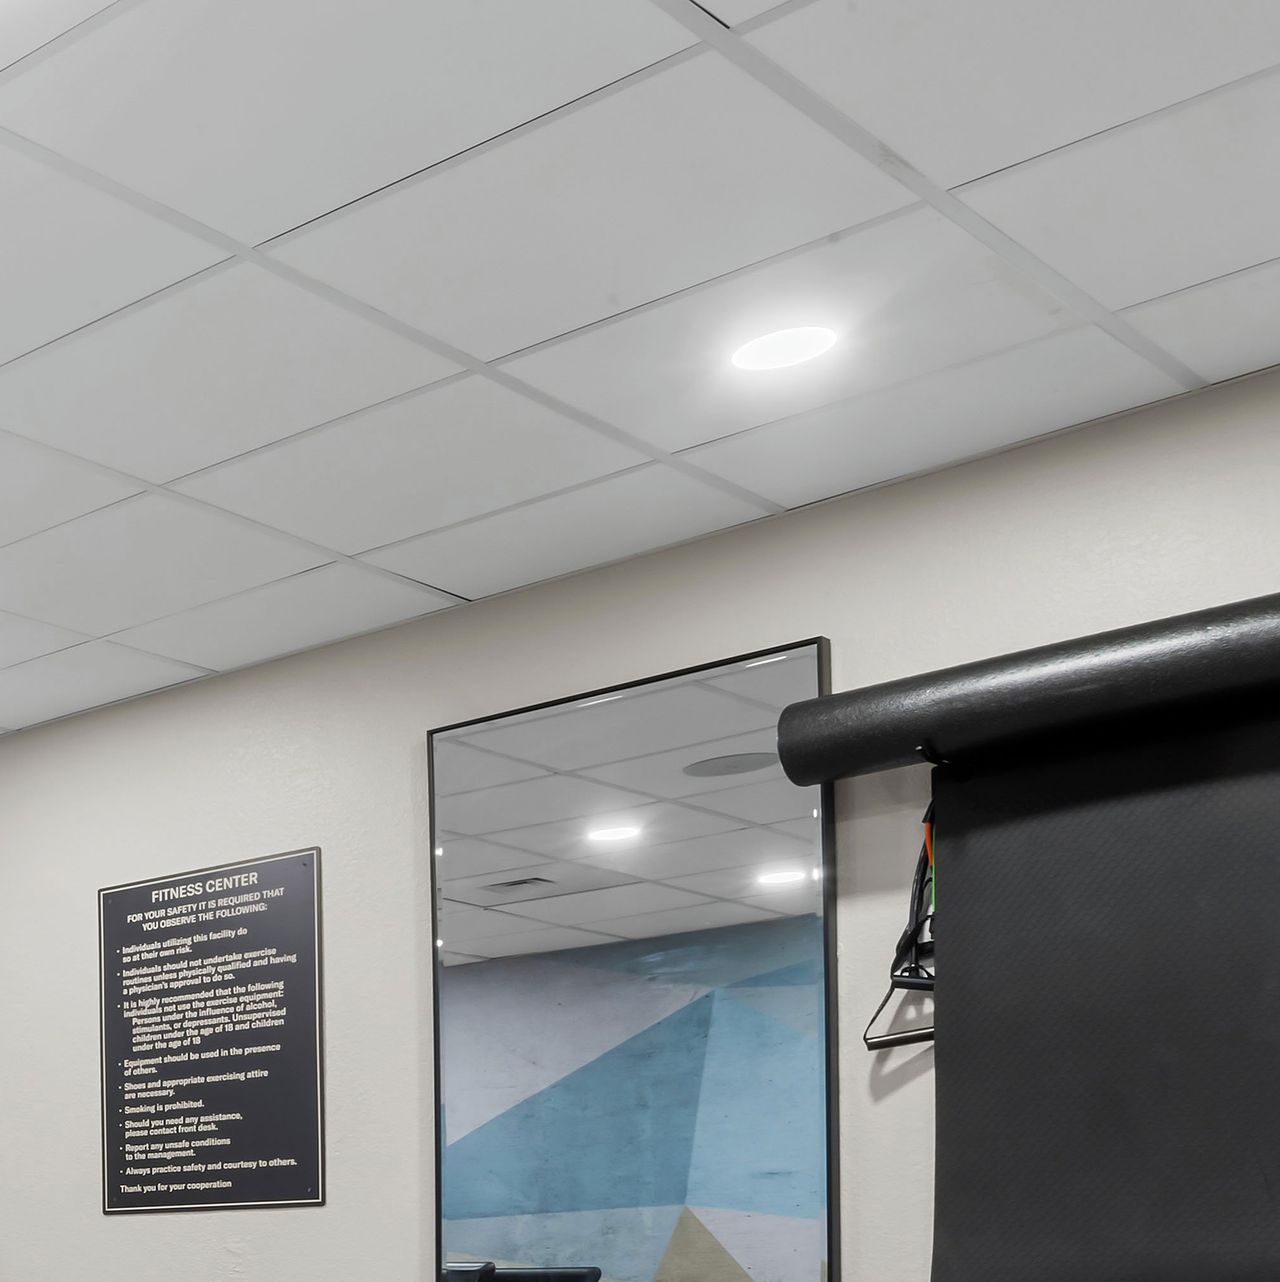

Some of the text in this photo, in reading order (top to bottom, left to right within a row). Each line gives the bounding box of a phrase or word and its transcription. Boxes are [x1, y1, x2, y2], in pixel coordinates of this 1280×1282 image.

[152, 872, 258, 902] FITNESS CENTER
[127, 887, 283, 923] FOR YOUR SAFETY IT IS REQUIRED THAT
[142, 903, 267, 931] YOU OBSERVE THE FOLLOWING:
[122, 927, 248, 954] Individuals utilizing this facility do
[123, 948, 276, 977] Individuals should not undertake exercise
[141, 950, 158, 959] their
[123, 954, 297, 986] routines unless physically qualified and having
[129, 982, 168, 995] physician's
[169, 976, 201, 988] approval
[212, 974, 222, 982] do
[123, 1001, 129, 1009] It
[162, 990, 214, 1003] recommended
[215, 988, 231, 996] that
[233, 986, 246, 994] the
[248, 981, 284, 991] following
[164, 1004, 176, 1012] not
[207, 996, 237, 1006] exercise
[132, 1017, 160, 1025] Persons
[163, 1013, 183, 1021] under
[236, 1003, 244, 1012] of
[232, 1007, 286, 1021] Unsupervised
[132, 1019, 284, 1043] children under the age of 18 and children
[132, 1036, 201, 1052] under the age of 18
[124, 1044, 281, 1069] Equipment should be used in the presence
[124, 1068, 132, 1076] of
[124, 1069, 268, 1091] Shoes and appropriate exercising attire
[125, 1105, 155, 1114] Smoking
[156, 1103, 163, 1111] is
[125, 1119, 150, 1128] Should
[151, 1120, 164, 1128] you
[165, 1116, 183, 1125] need
[185, 1117, 199, 1125] any
[125, 1129, 148, 1139] please
[149, 1126, 177, 1135] contact
[178, 1123, 196, 1133] front
[125, 1144, 149, 1153] Report
[165, 1140, 190, 1149] unsafe
[191, 1138, 231, 1147] conditions
[134, 1152, 146, 1160] the
[126, 1167, 151, 1176] Always
[152, 1165, 181, 1175] practice
[183, 1163, 206, 1172] safety
[207, 1161, 222, 1170] and
[223, 1161, 257, 1169] courtesy
[121, 1180, 232, 1193] Thank you for your cooperation
